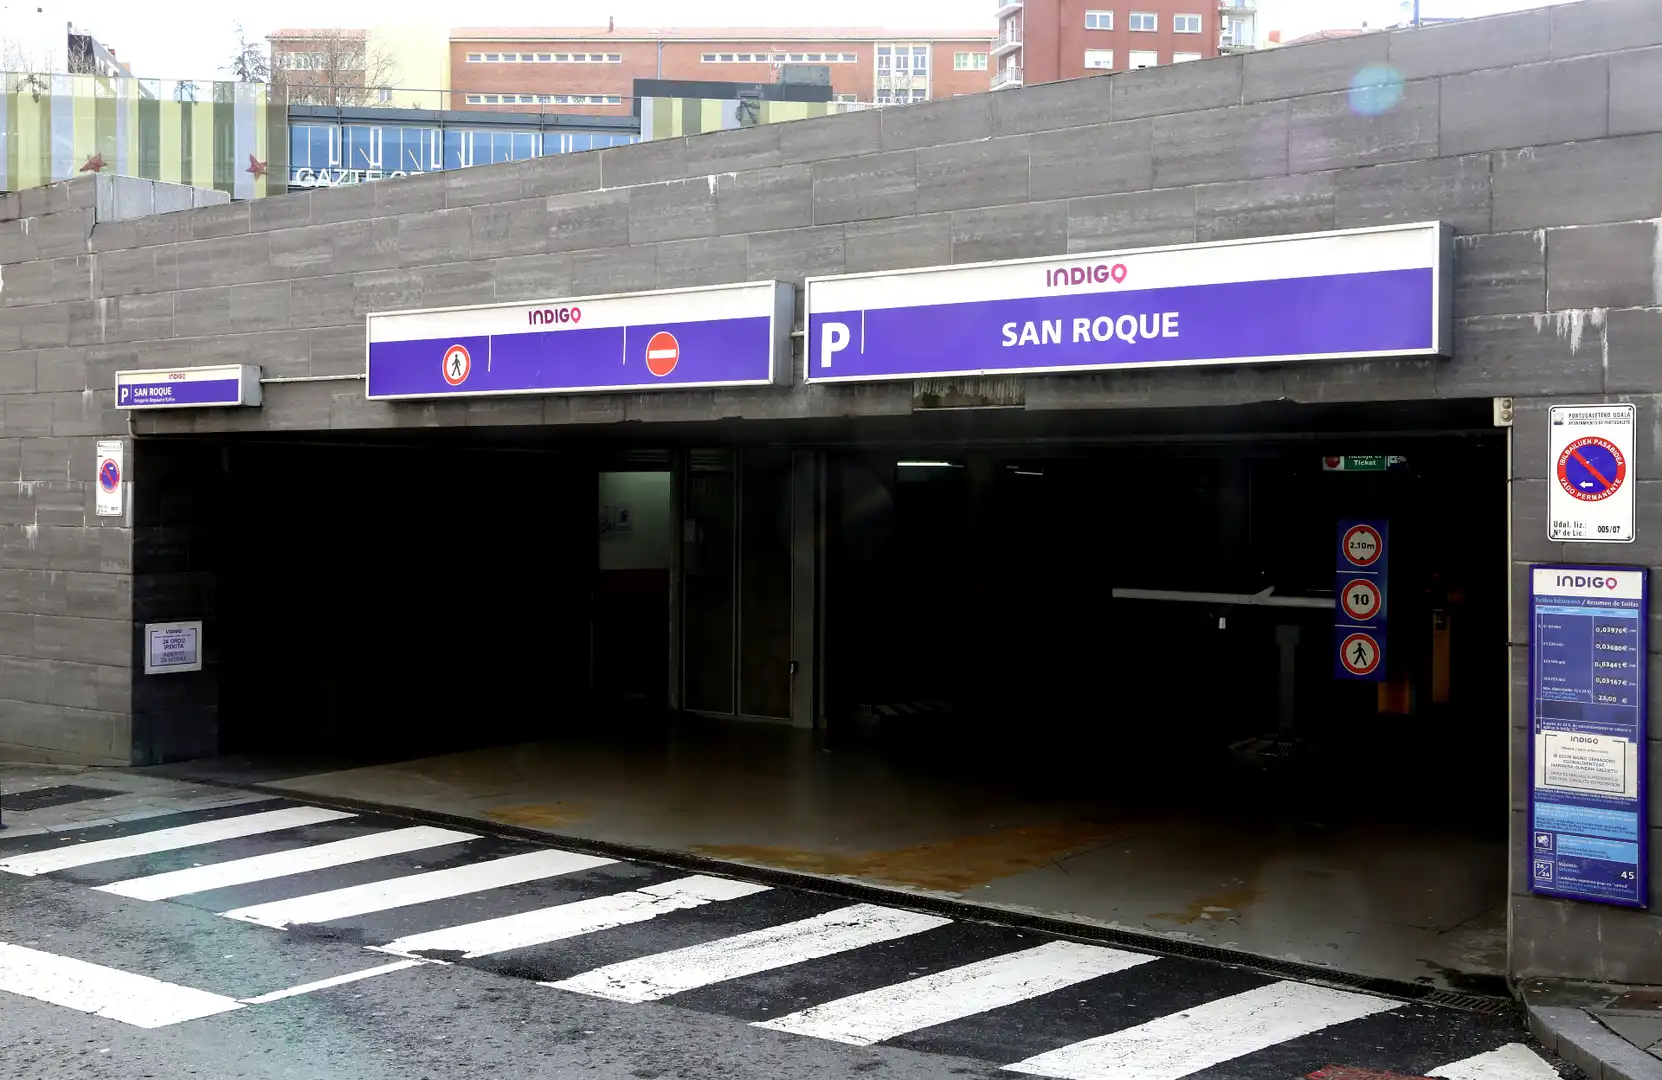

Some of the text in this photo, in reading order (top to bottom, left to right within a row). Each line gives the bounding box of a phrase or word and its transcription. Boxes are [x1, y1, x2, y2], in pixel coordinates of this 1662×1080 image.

[1046, 263, 1128, 288] INDIGO
[528, 306, 582, 326] INDIGO
[1001, 312, 1180, 347] SAN ROQUE
[820, 322, 850, 368] P
[121, 388, 128, 403] P
[134, 386, 172, 397] SAN ROQUE
[1559, 438, 1623, 466] IBILBAILUEN PASABIDEA
[1559, 477, 1622, 501] VADO PERMANENTE
[1597, 526, 1621, 534] 005/07
[1556, 575, 1618, 590] INDIGO
[1353, 594, 1369, 605] 10
[1570, 736, 1598, 744] INDIGO
